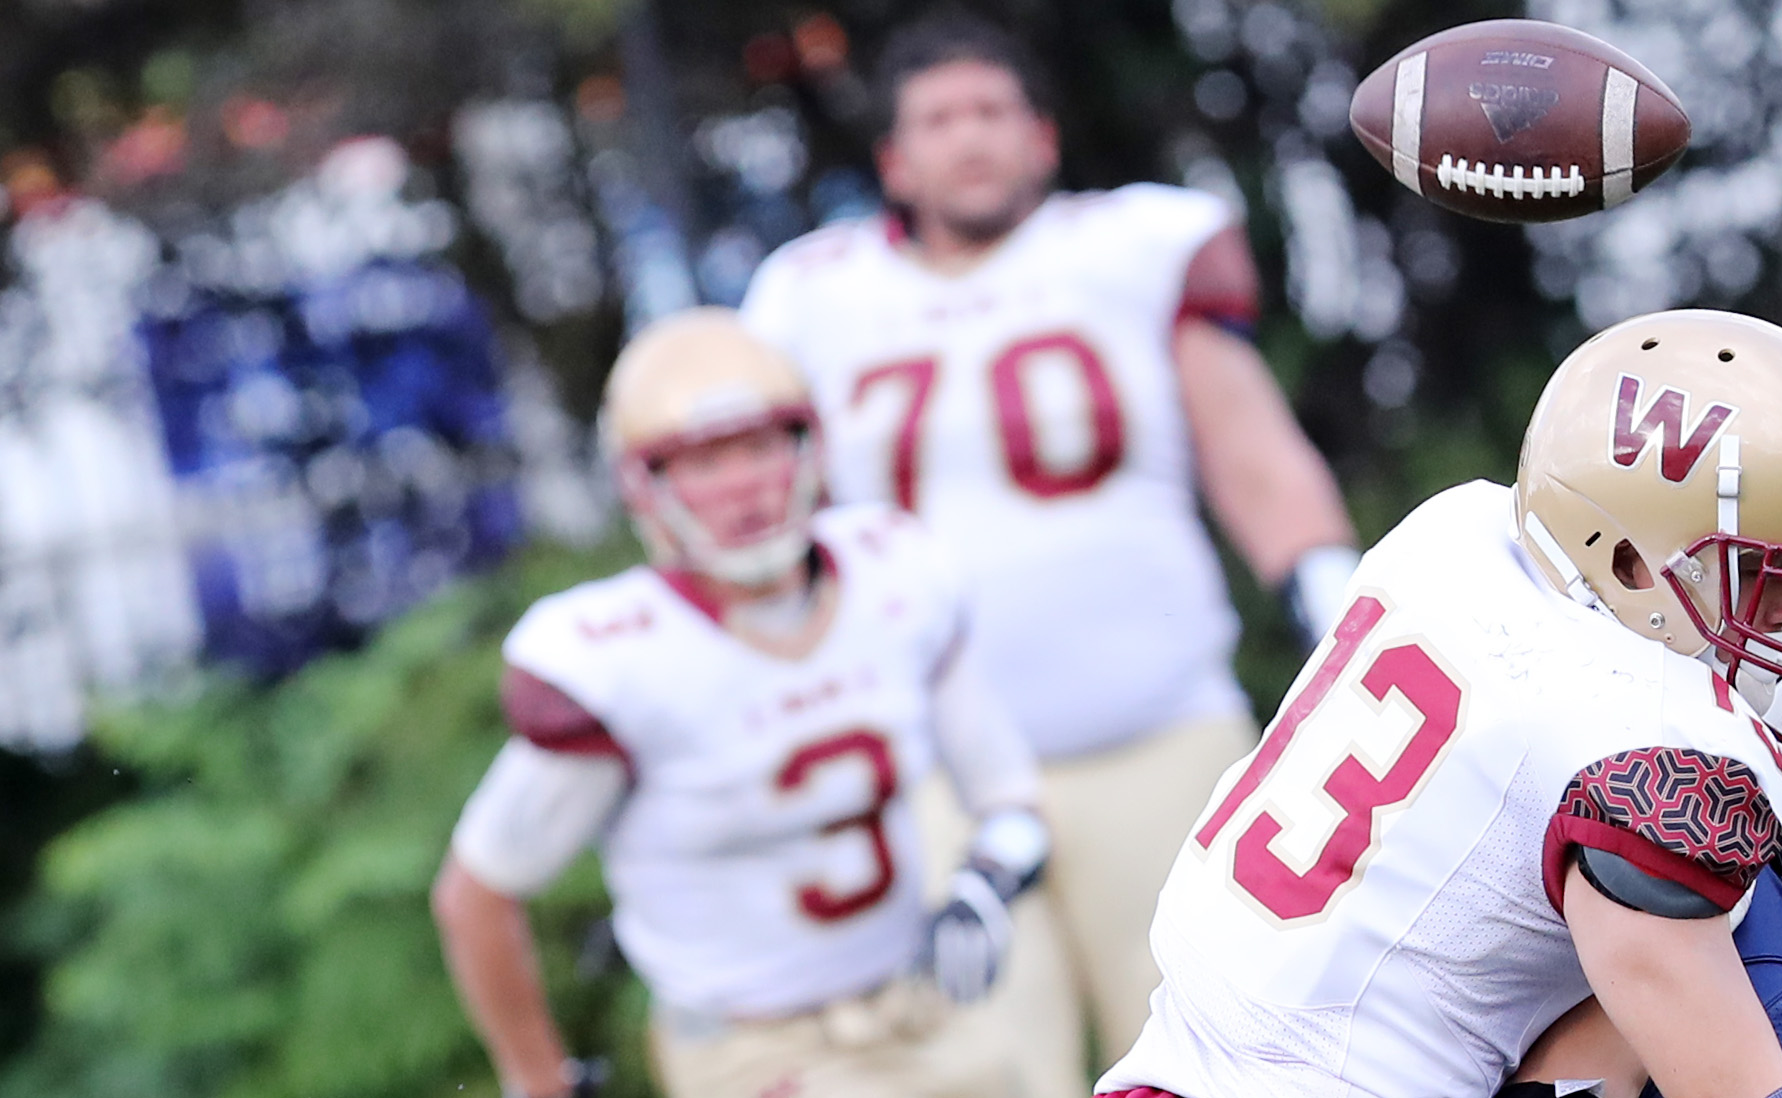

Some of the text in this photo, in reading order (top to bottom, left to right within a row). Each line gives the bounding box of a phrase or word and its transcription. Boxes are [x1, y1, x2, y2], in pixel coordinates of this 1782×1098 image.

[848, 331, 1125, 512] 70
[1610, 373, 1738, 484] W
[773, 728, 897, 924] 3
[1192, 590, 1468, 924] 13
